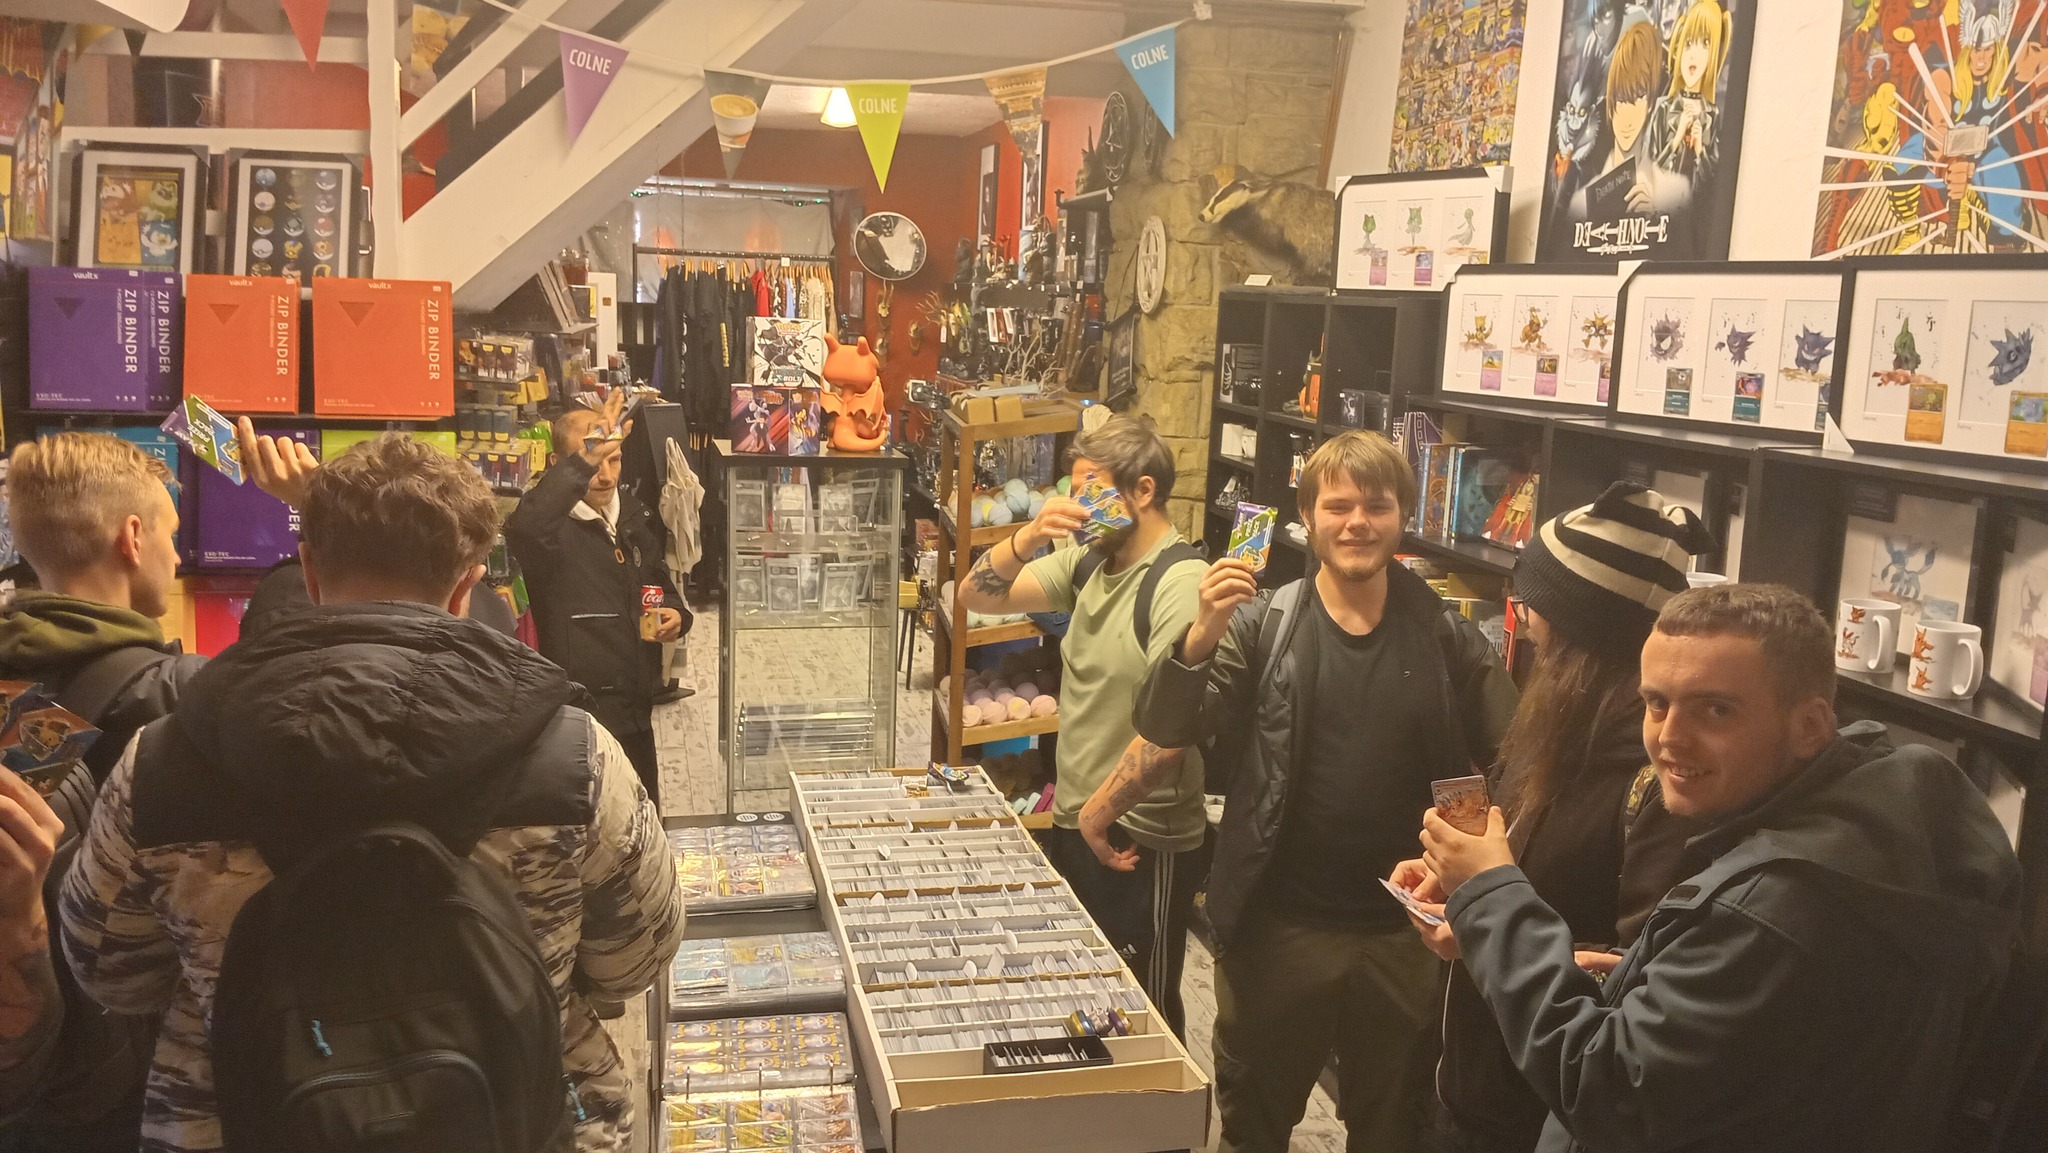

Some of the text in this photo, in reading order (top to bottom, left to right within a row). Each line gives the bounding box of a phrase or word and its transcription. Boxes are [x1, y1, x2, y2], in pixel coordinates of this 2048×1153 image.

[569, 48, 612, 76] COLNE
[1131, 44, 1169, 70] COLNE
[859, 97, 898, 114] COLNE
[124, 289, 138, 374] ZIP BINDER
[157, 290, 171, 374] ZIP BINDER
[276, 296, 289, 376] ZIP BINDER
[427, 300, 440, 380] ZIP BINDER
[154, 447, 167, 460] ZI
